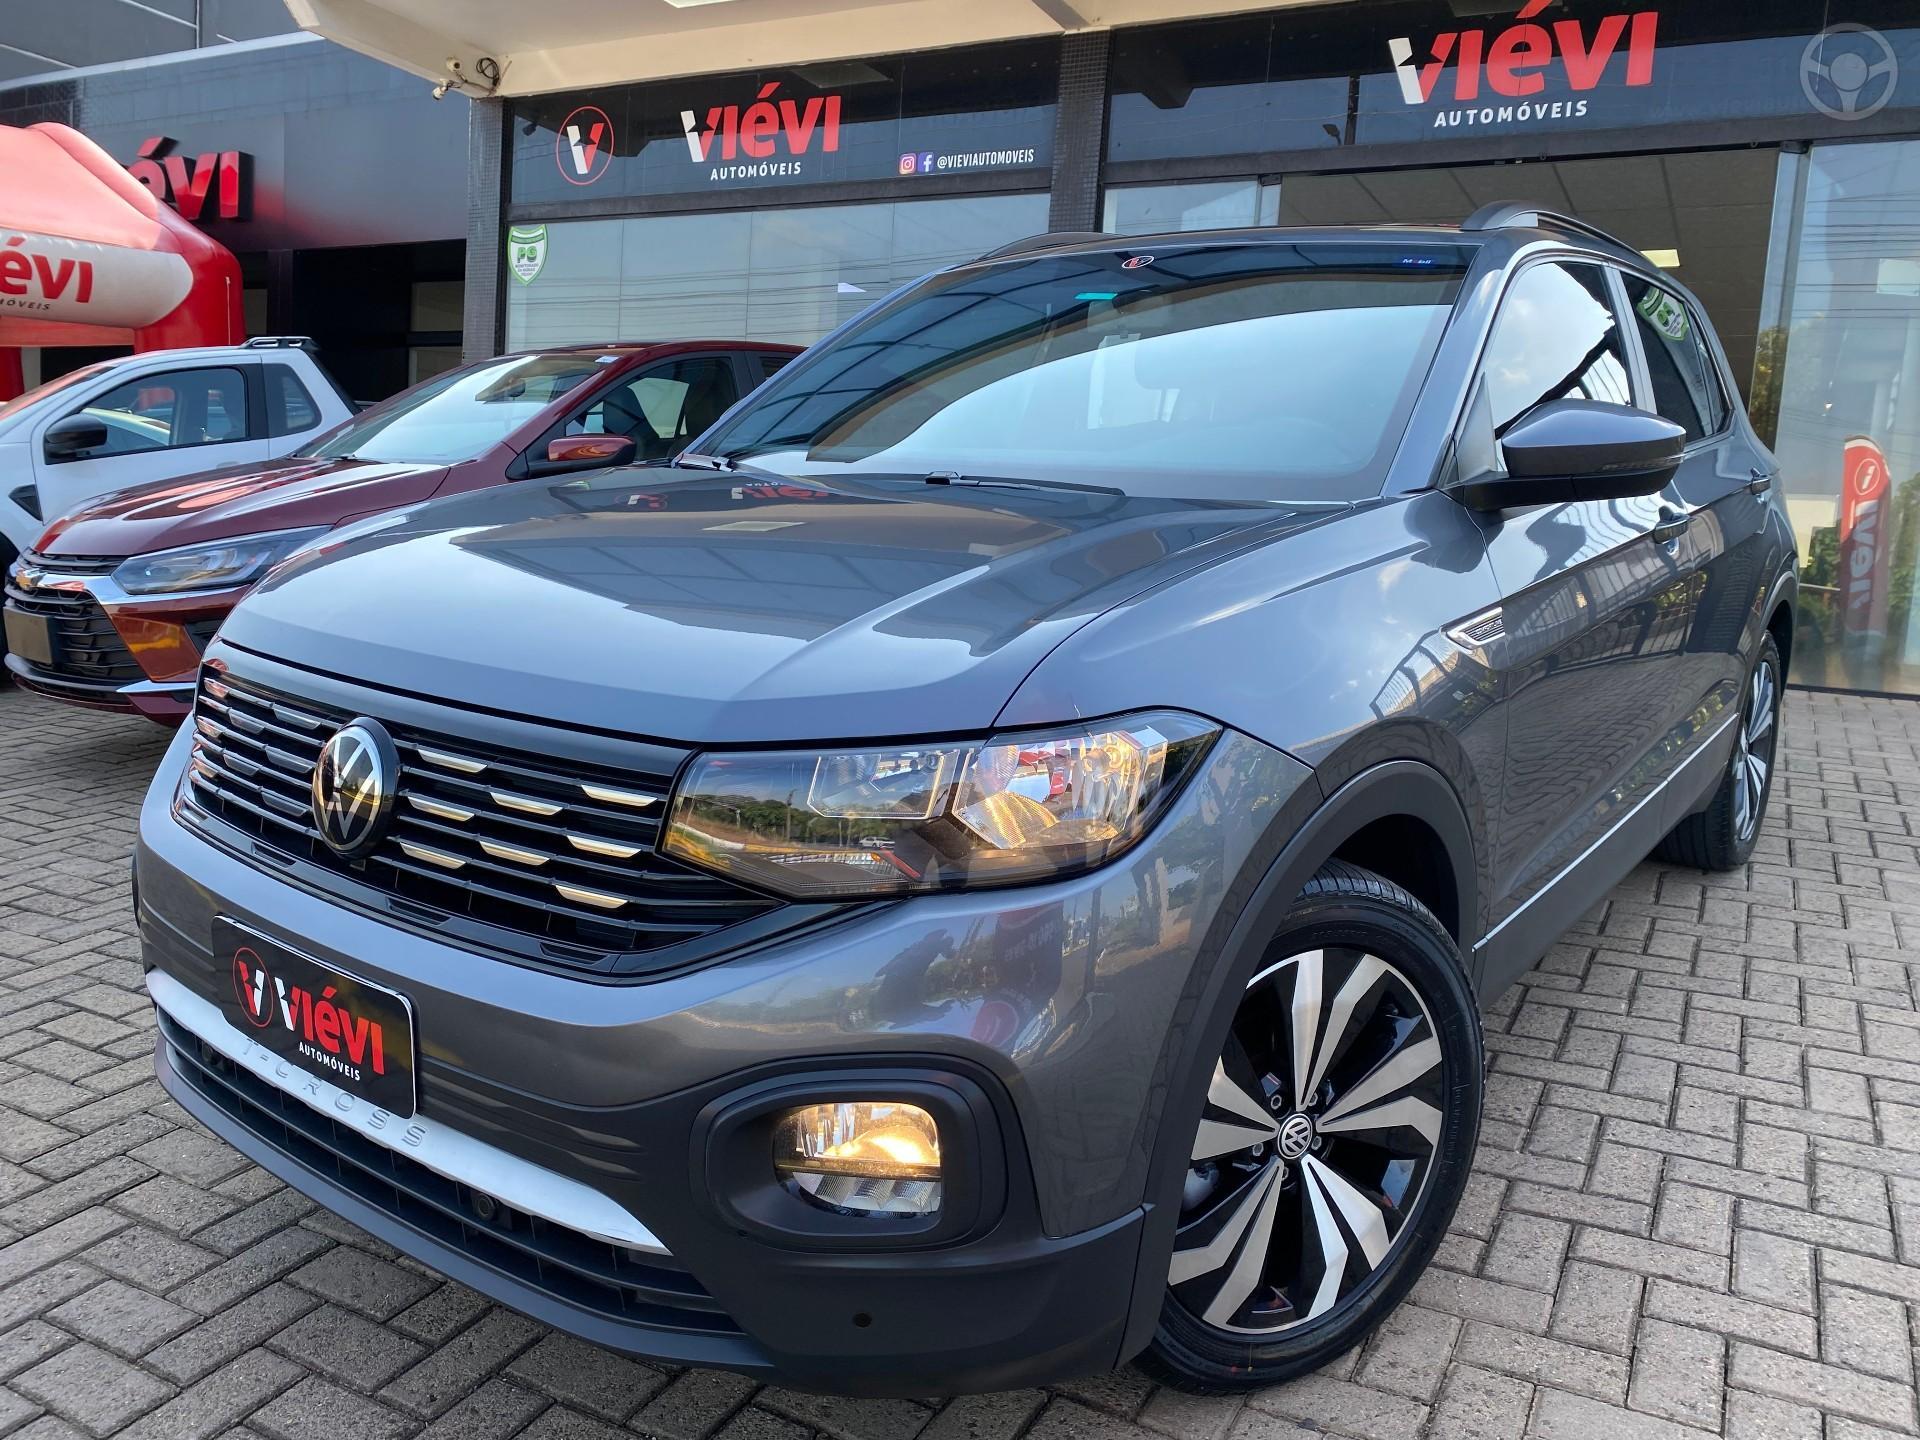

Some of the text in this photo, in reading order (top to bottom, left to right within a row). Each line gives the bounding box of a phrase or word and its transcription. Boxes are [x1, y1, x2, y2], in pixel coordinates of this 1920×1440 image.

[1434, 100, 1588, 128] AUTOMÓVEIS
[710, 161, 802, 181] AUTOMÓVEIS
[937, 149, 1035, 169] @VIEVIAUTOMOVEIS
[0, 297, 51, 311] ÓVEIS
[299, 1041, 361, 1082] AUTOMÓVEIS
[243, 1037, 429, 1147] T-CROSS
